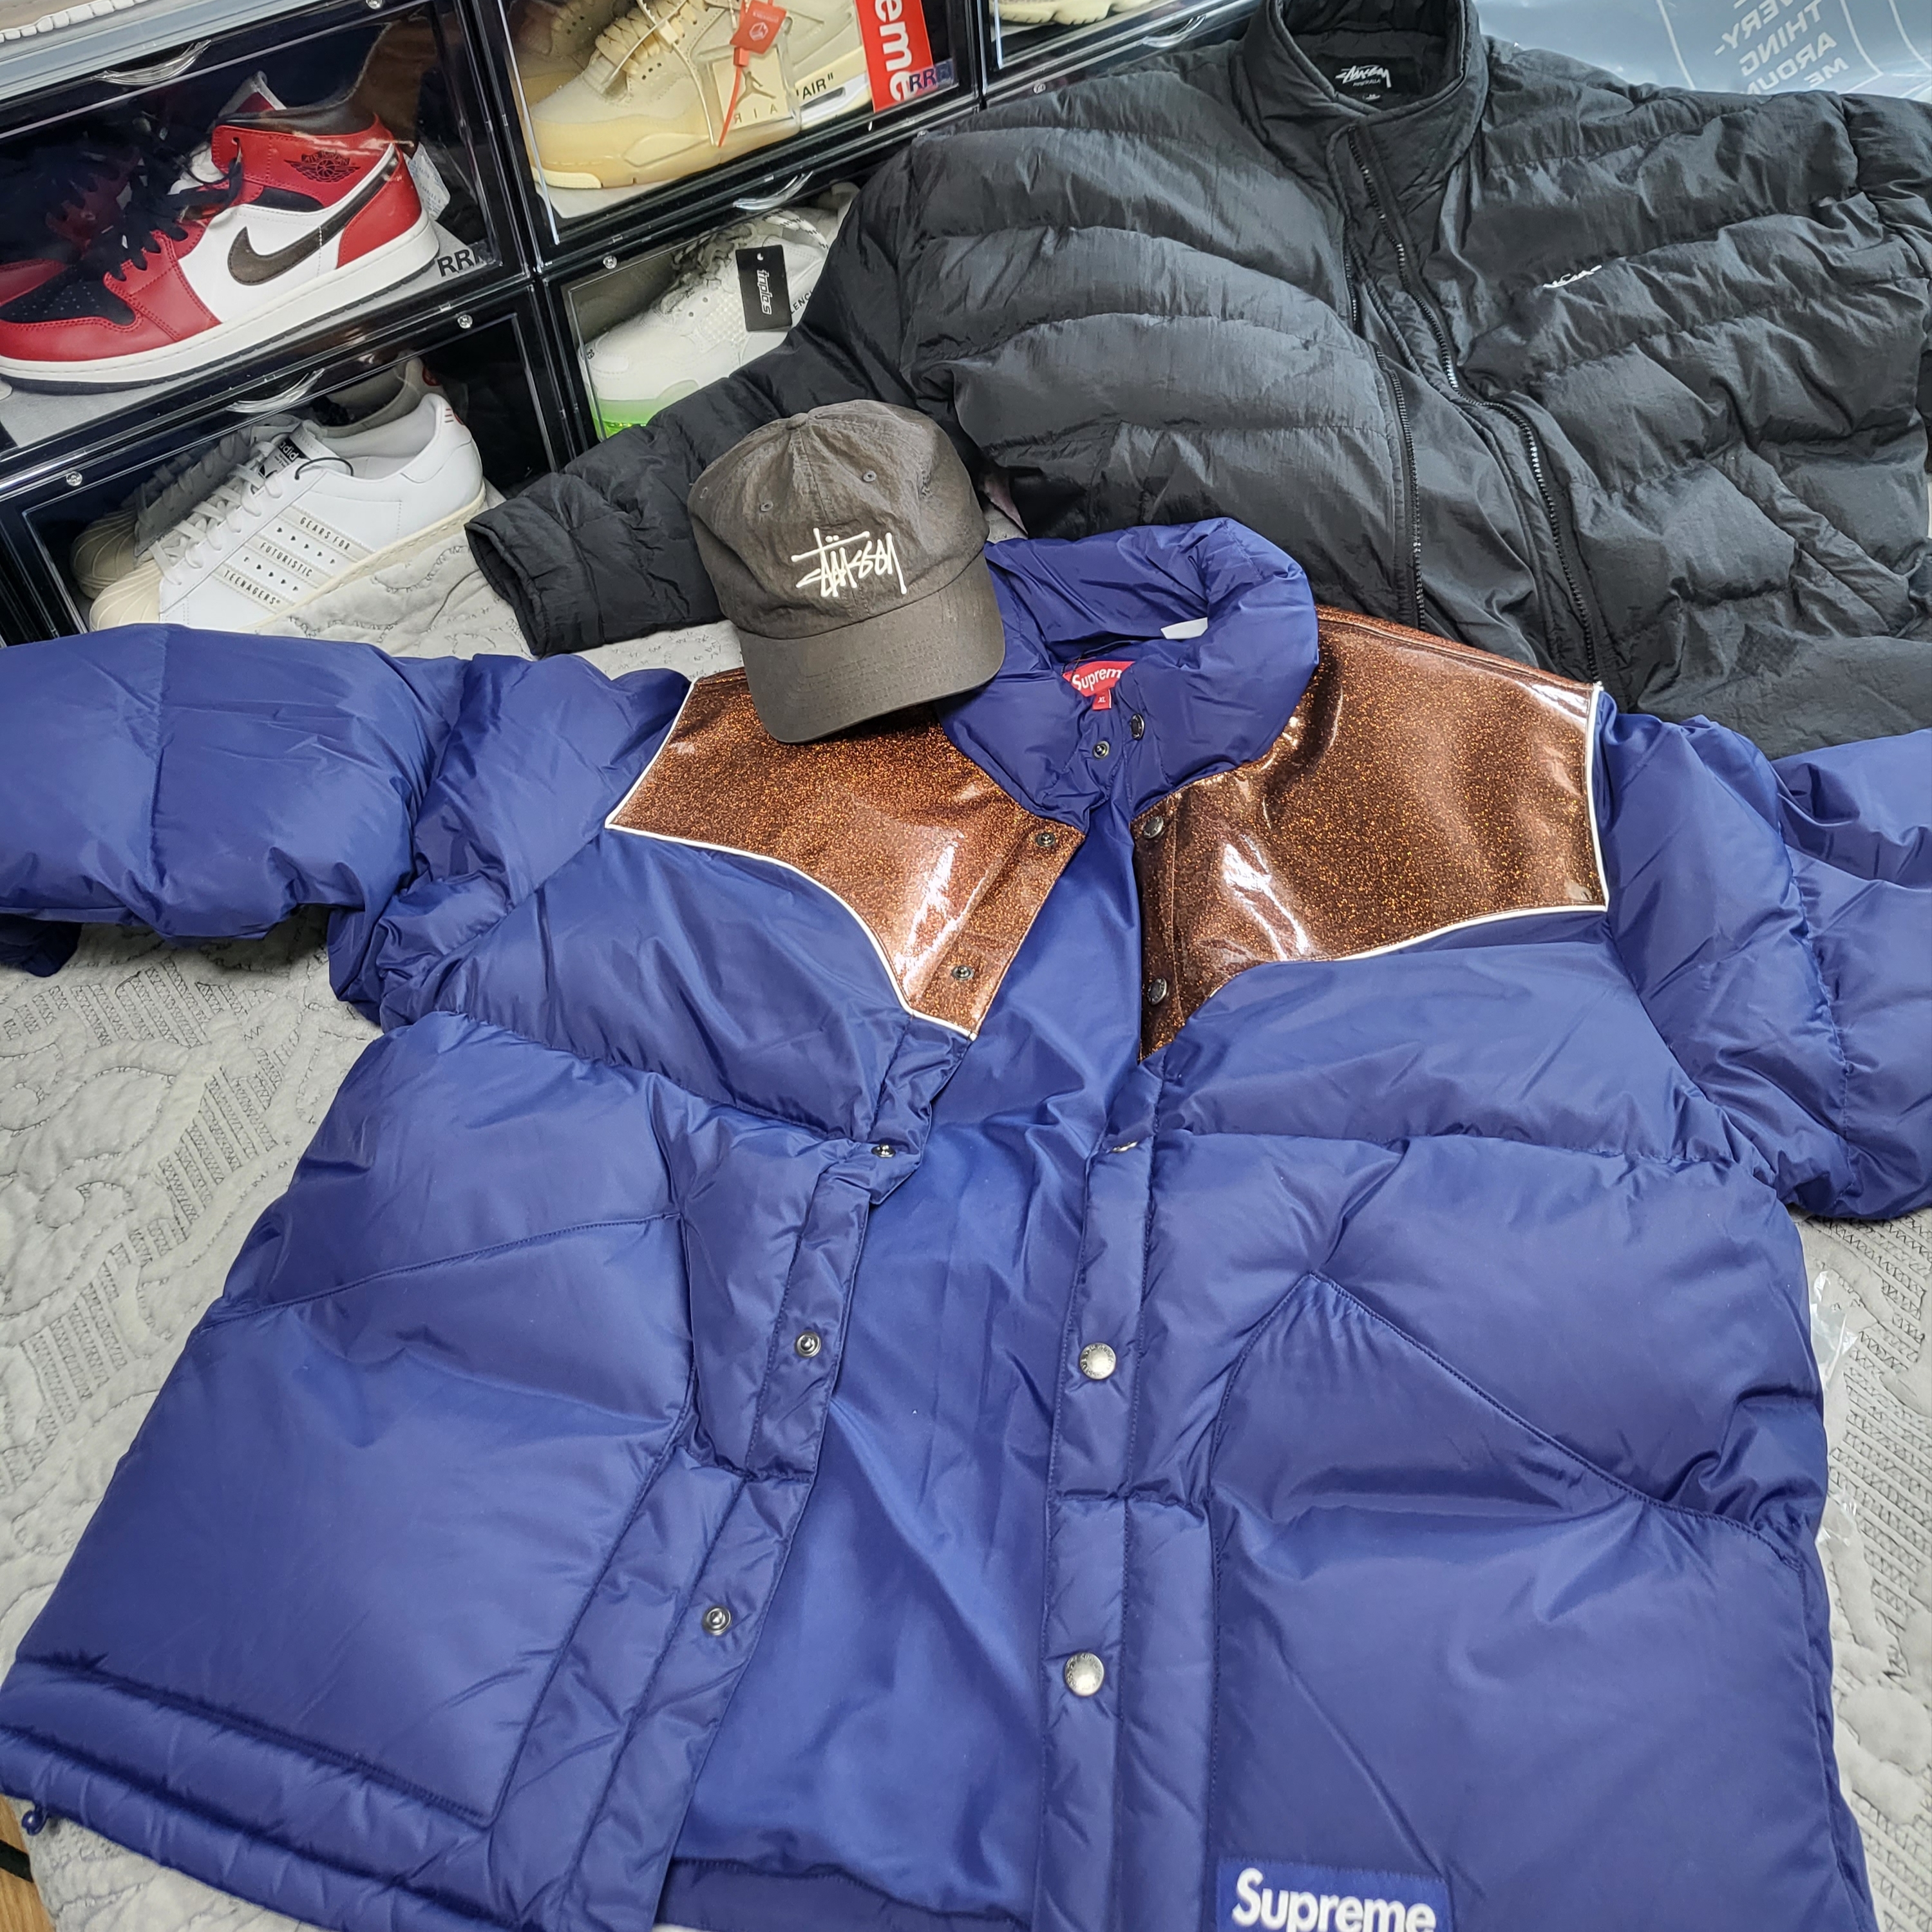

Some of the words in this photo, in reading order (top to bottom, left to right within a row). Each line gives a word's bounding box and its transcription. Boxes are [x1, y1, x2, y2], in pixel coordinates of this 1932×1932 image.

[305, 153, 319, 162] AIR
[300, 517, 331, 539] GEARS
[332, 536, 350, 551] FOR
[260, 542, 313, 577] FUTURISTIC
[1072, 668, 1122, 691] Suprem
[1231, 1867, 1437, 1932] Supreme
